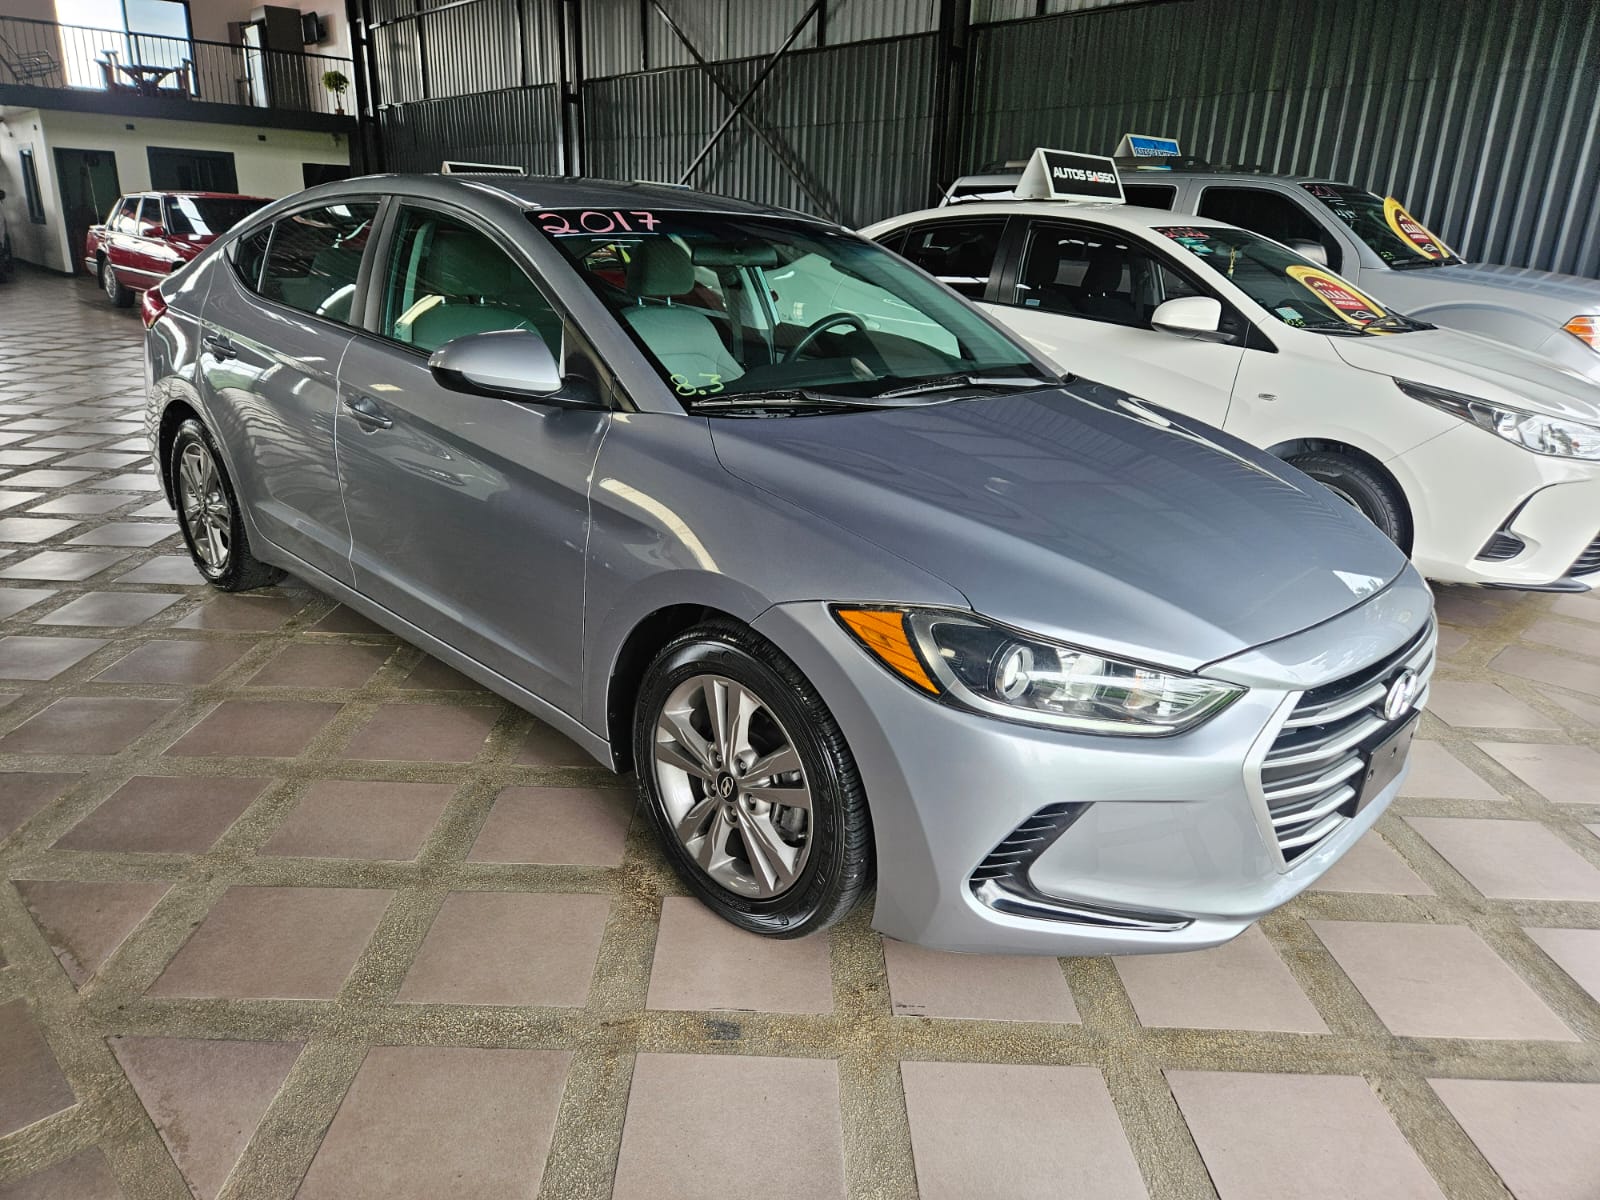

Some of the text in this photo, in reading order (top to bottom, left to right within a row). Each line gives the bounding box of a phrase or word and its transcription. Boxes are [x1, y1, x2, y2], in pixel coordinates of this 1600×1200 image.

[1053, 166, 1087, 181] AUTOS
[538, 211, 662, 234] 2017
[670, 373, 725, 396] 8.3
